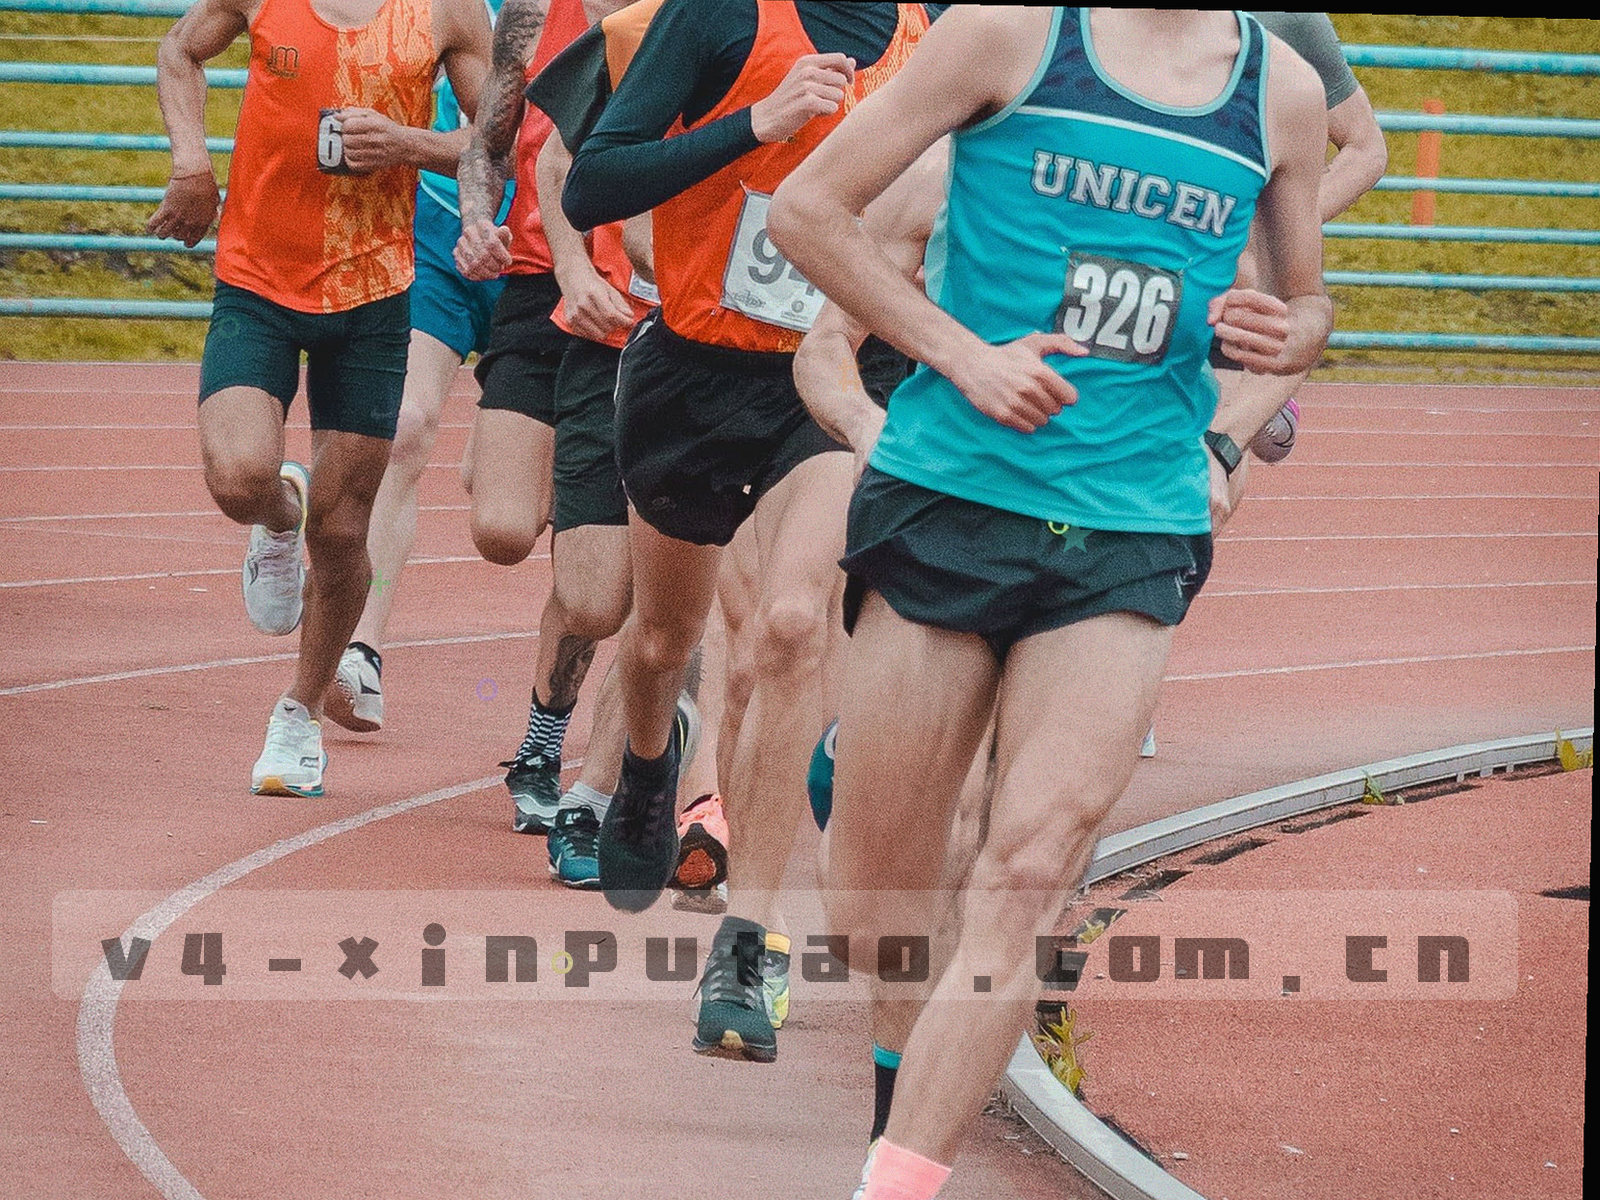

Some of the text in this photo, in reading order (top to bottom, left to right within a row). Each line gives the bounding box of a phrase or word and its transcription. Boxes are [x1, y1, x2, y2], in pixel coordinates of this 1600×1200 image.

[318, 115, 344, 168] 6
[1031, 149, 1238, 238] UNICEN
[1062, 262, 1175, 355] 326
